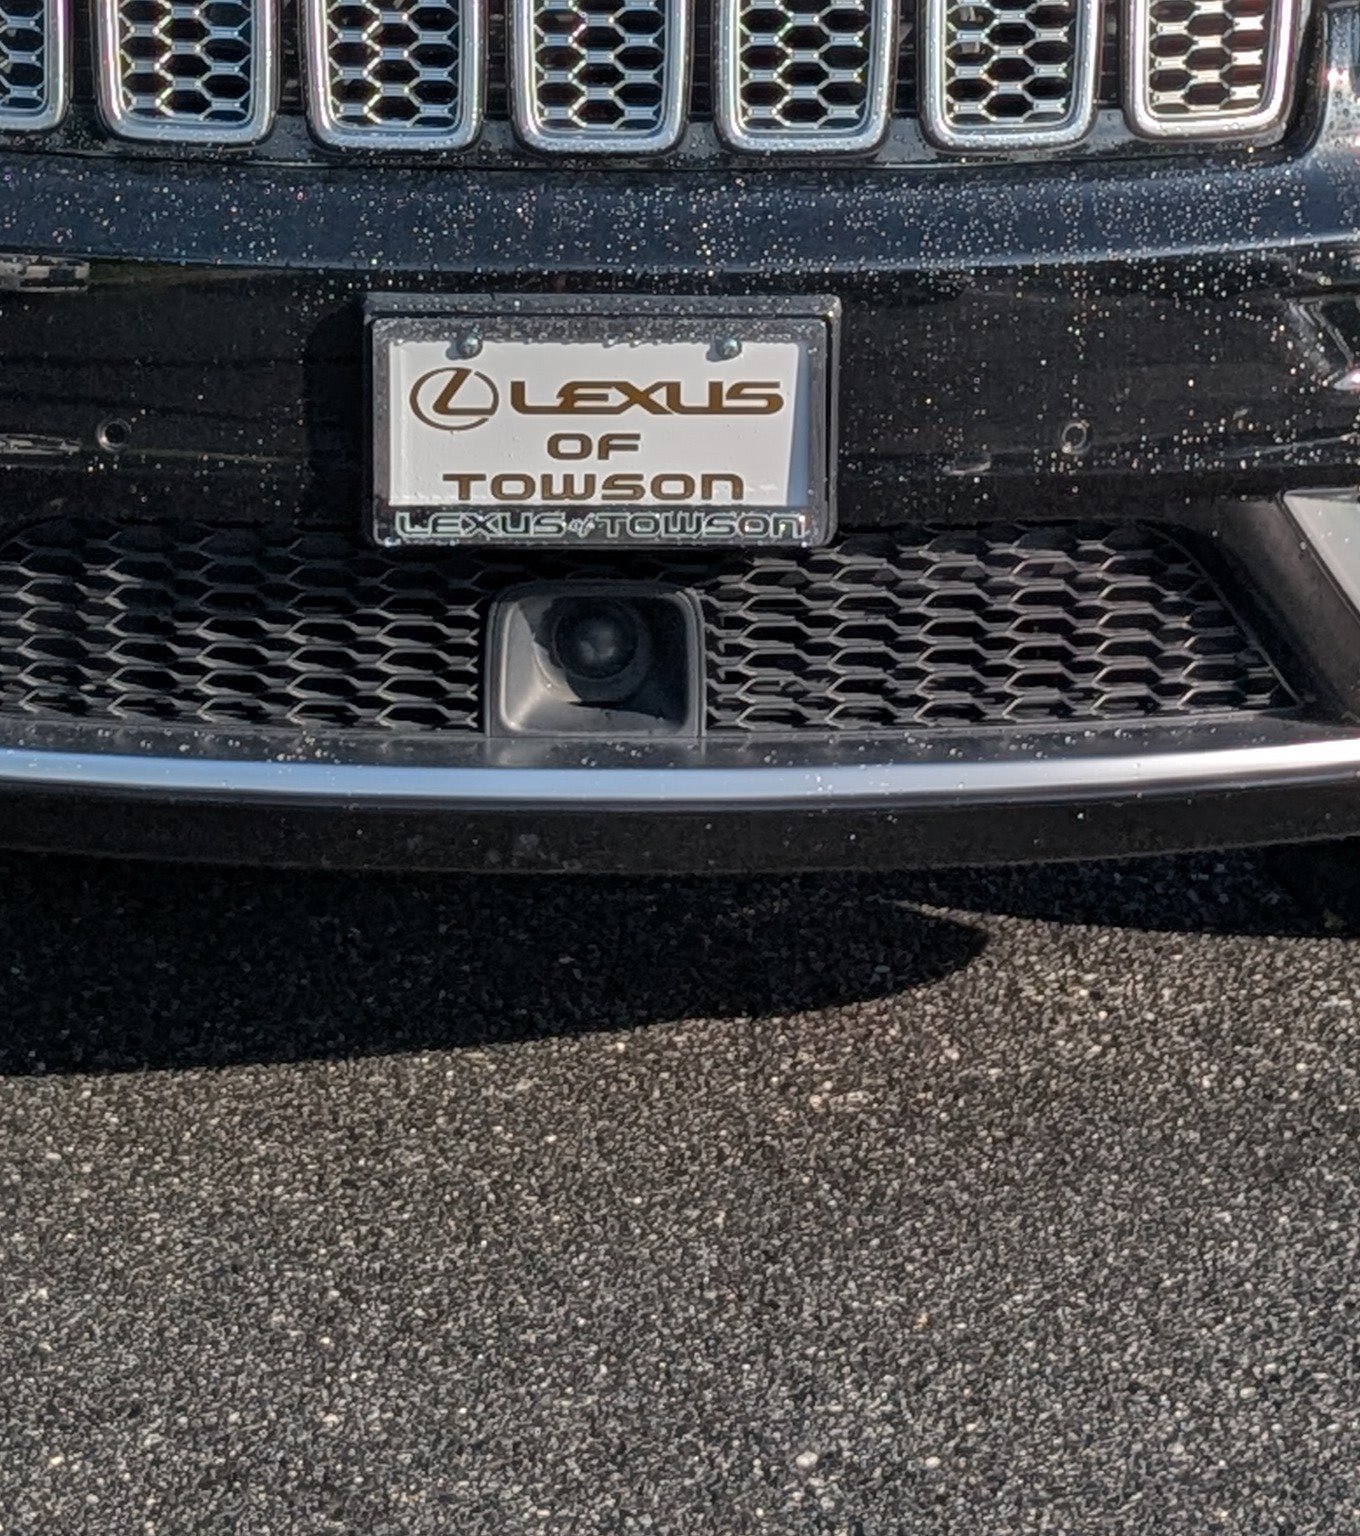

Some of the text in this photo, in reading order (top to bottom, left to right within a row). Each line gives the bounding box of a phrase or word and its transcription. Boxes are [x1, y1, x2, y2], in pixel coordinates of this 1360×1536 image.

[510, 380, 785, 416] LEXUS
[546, 432, 642, 461] OF
[442, 472, 745, 502] TOWSON
[394, 511, 566, 538] LEXUS
[597, 512, 805, 539] TOWSON
